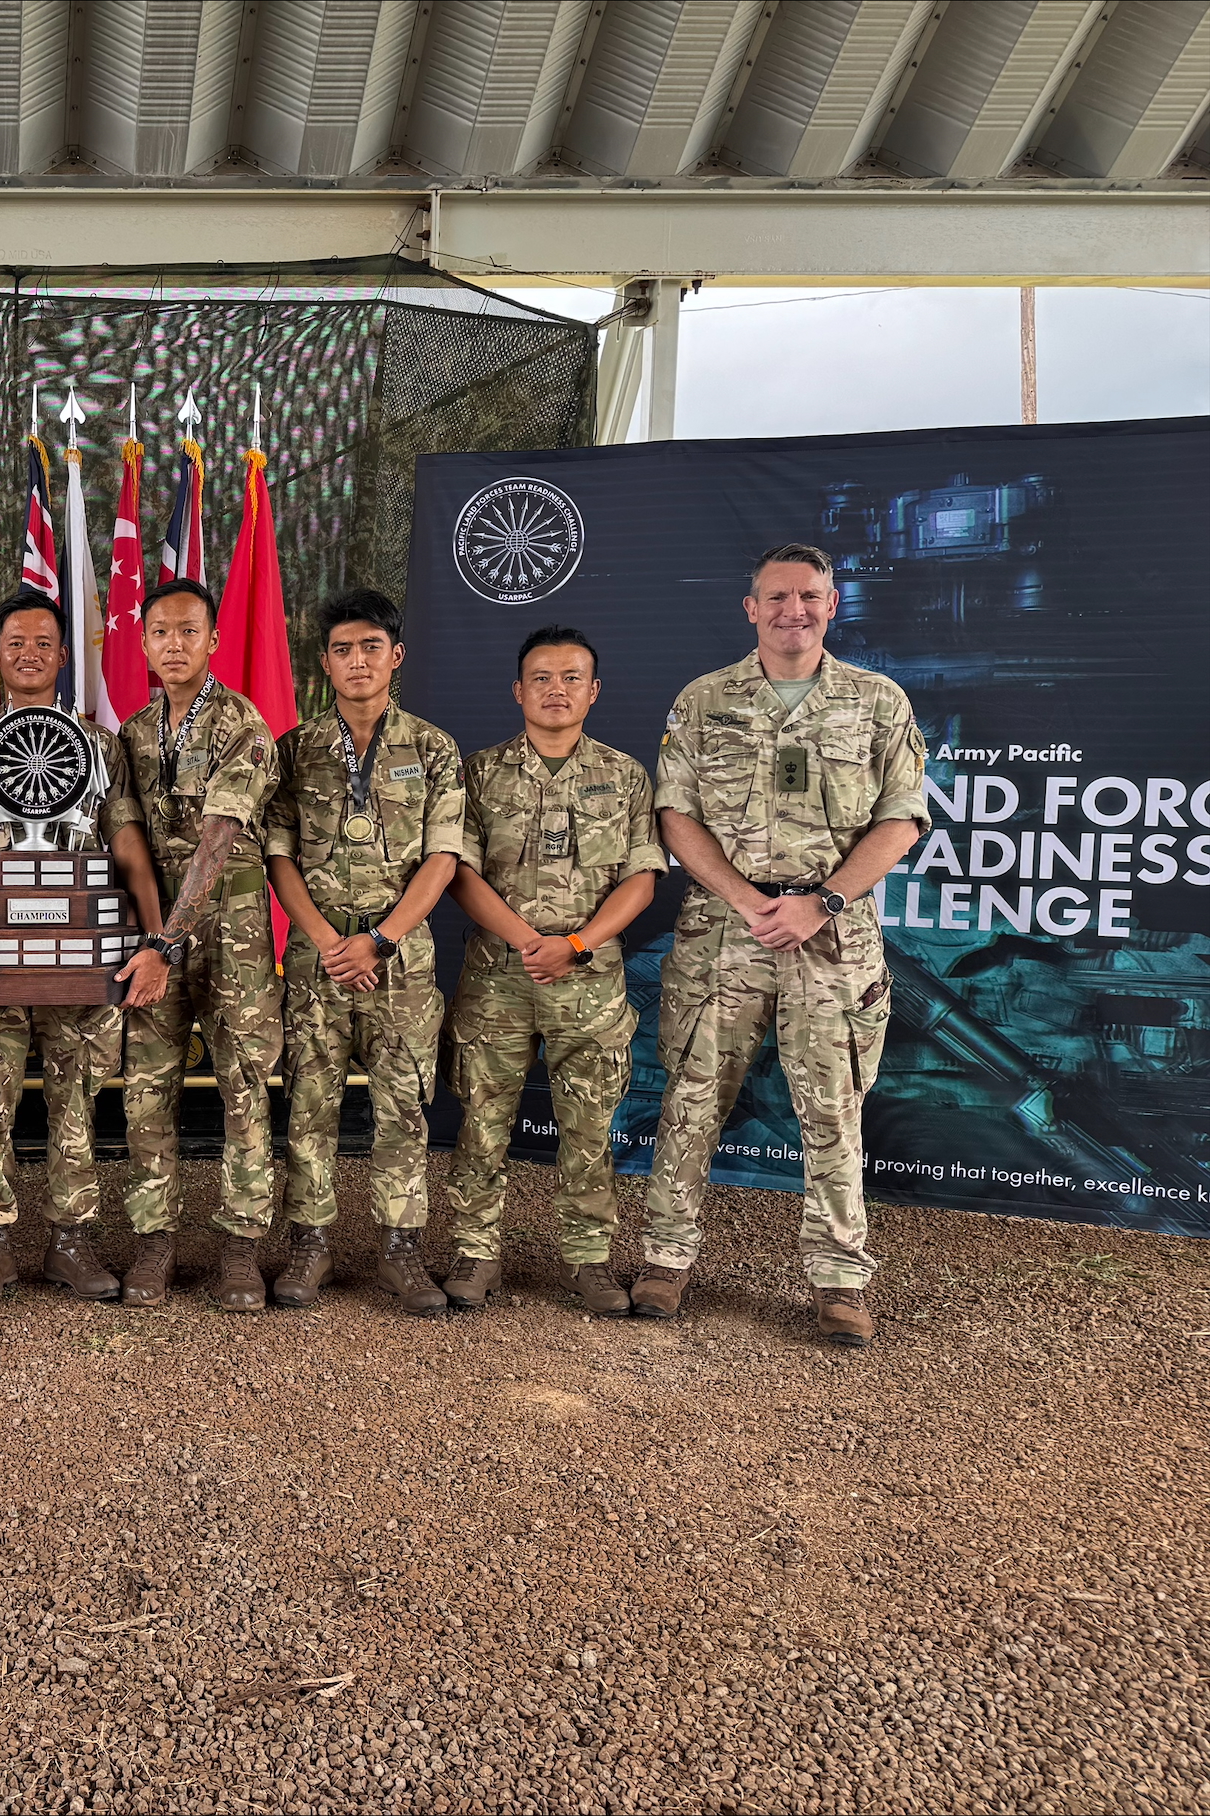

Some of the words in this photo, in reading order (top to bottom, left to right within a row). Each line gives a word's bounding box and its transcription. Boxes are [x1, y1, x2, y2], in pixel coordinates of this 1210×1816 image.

[31, 249, 52, 260] USA
[458, 528, 467, 556] PACIFIC
[463, 506, 478, 527] LAND
[476, 487, 503, 507] FORCES
[504, 483, 526, 491] TEAM
[528, 484, 566, 509] READINESS
[563, 508, 578, 553] CHALLENGE
[498, 592, 533, 601] USARPAC
[2, 716, 26, 733] FORCES
[45, 716, 77, 739] READINESS
[175, 720, 191, 752] PACIFIC
[187, 696, 204, 720] LAND
[186, 755, 200, 765] SITAL
[347, 754, 358, 773] 2026
[936, 743, 1002, 766] Army
[1008, 743, 1083, 763] Pacific
[393, 766, 420, 778] NISHAN
[923, 774, 1020, 823] ND
[889, 829, 1210, 885] ADINESS
[9, 910, 68, 921] CHAMPIONS
[880, 881, 1133, 938] LLENGE
[522, 1118, 558, 1136] Push
[609, 1128, 633, 1146] its,
[717, 1144, 761, 1158] verse
[874, 1155, 944, 1180] proving
[950, 1161, 986, 1180] that
[991, 1167, 1077, 1191] together,
[1083, 1177, 1191, 1201] excellence
